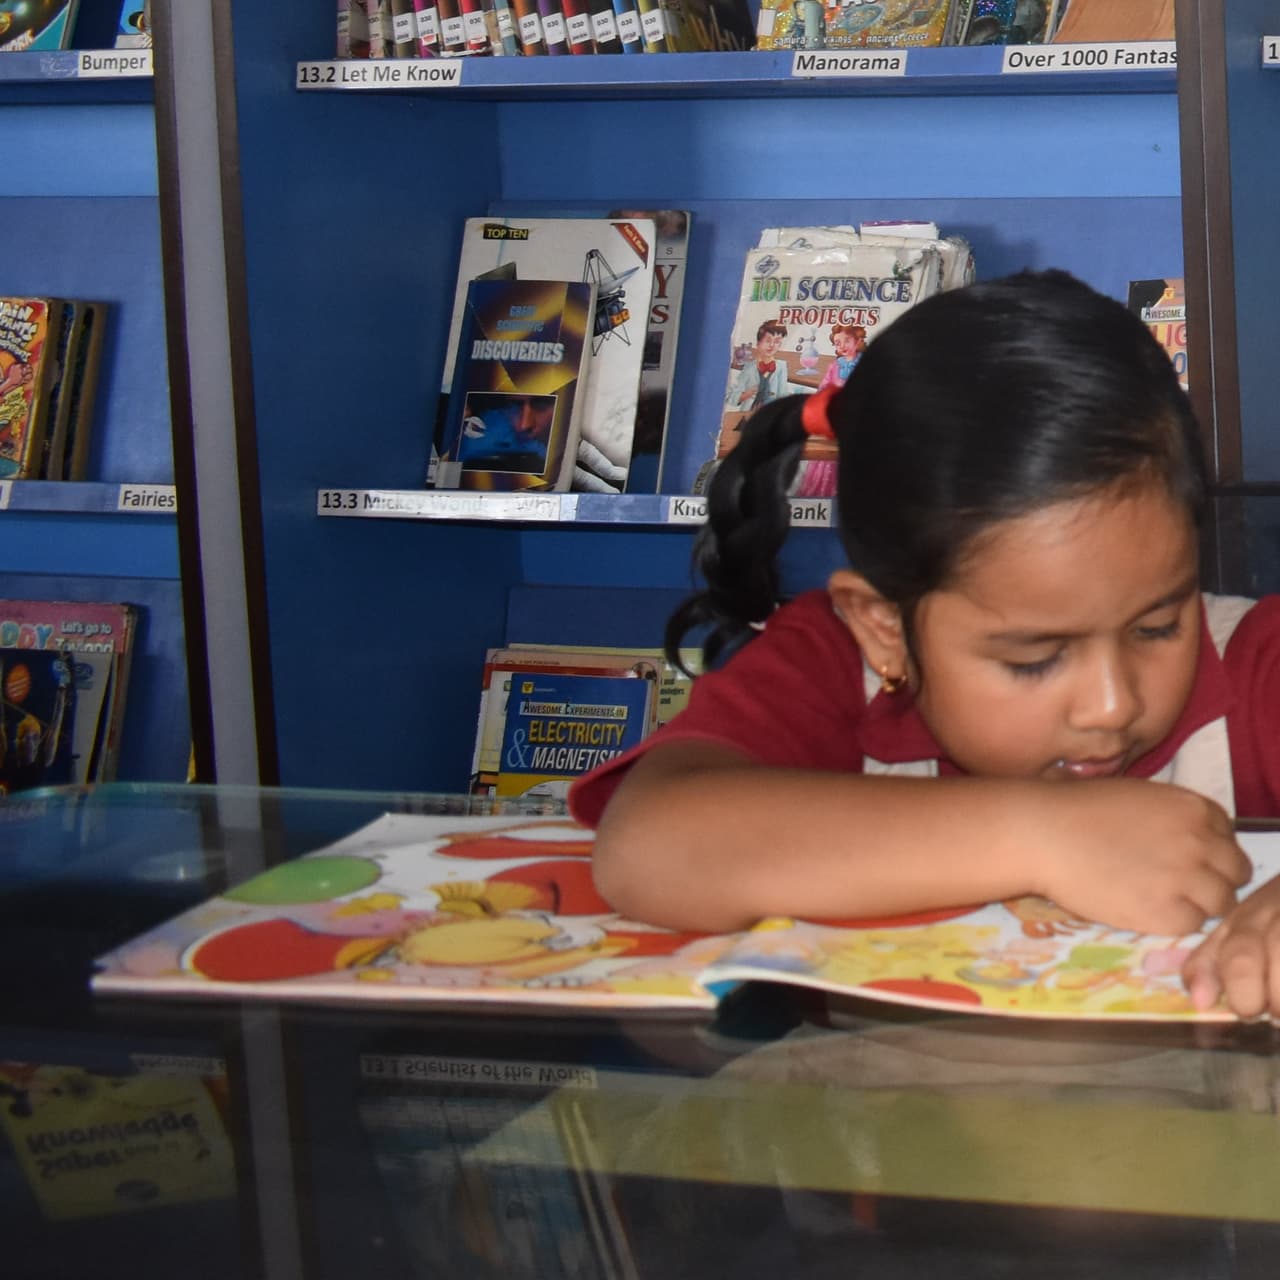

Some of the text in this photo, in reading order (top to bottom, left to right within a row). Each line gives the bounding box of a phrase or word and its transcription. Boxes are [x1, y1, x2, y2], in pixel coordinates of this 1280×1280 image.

[82, 55, 147, 73] Bumper
[797, 54, 900, 72] Manorama
[1008, 52, 1059, 69] Over
[1063, 49, 1109, 67] 1000
[299, 63, 457, 85] 13.2 Let Me Know
[486, 228, 528, 240] TOP TEN
[749, 276, 912, 303] 101 SCIENCE
[776, 305, 880, 328] PROJECTS
[471, 340, 565, 363] DISCOVERIES
[123, 489, 175, 509] Fairies
[321, 491, 358, 509] 13.3
[528, 720, 627, 745] ELECTRICITY
